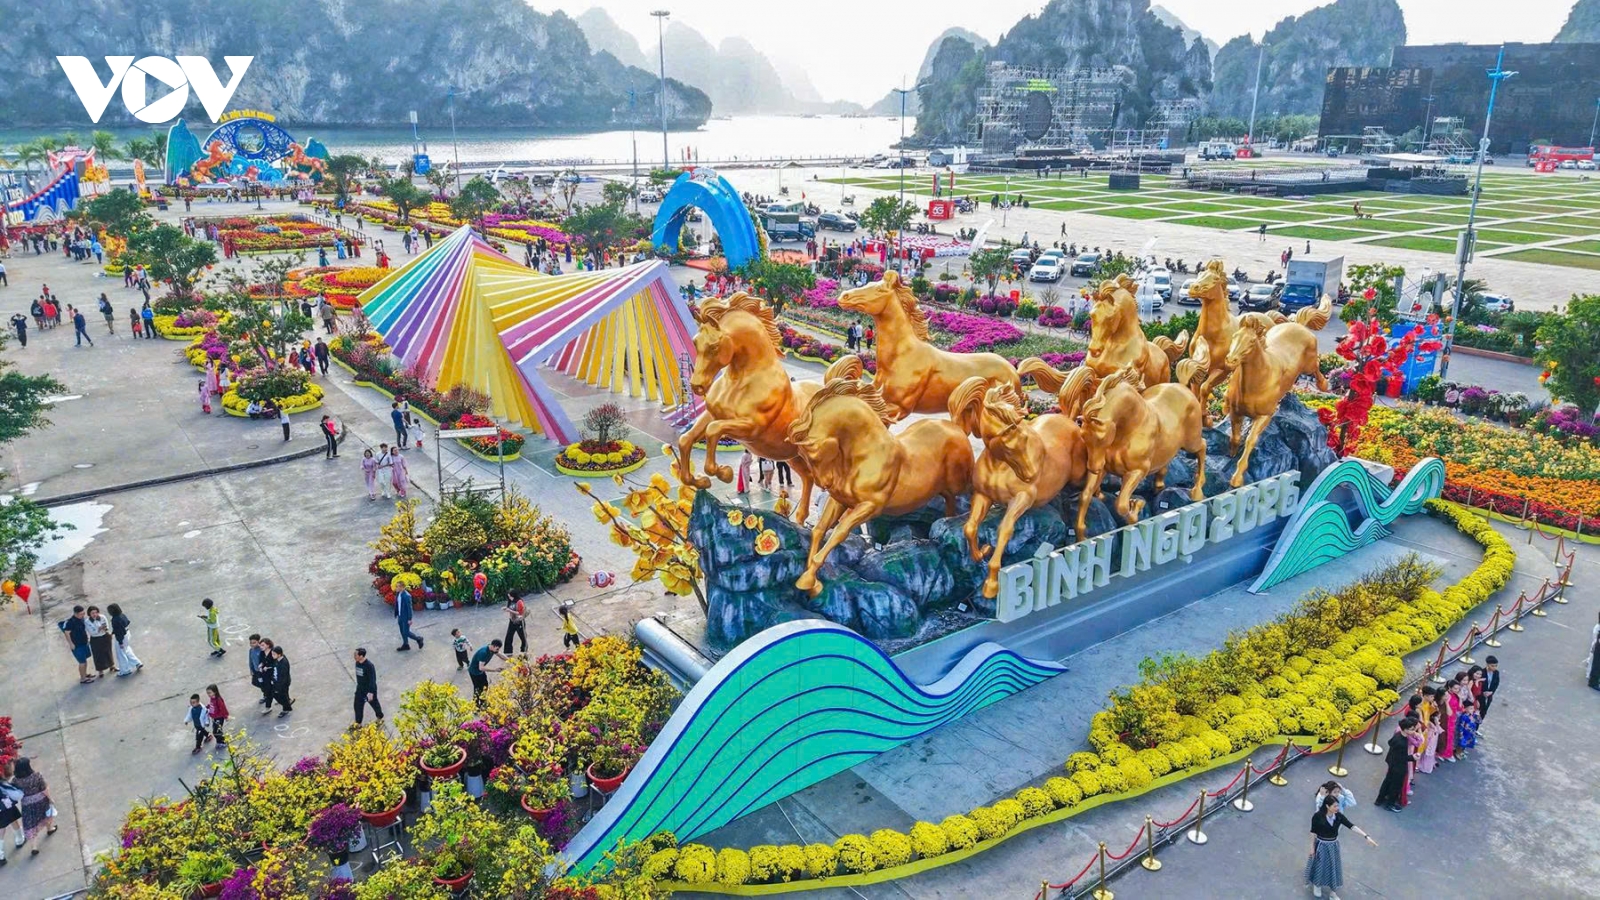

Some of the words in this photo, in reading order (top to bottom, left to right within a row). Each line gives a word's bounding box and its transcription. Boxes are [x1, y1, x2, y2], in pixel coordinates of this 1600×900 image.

[996, 534, 1113, 623] BÍNH
[1119, 502, 1207, 578] NGỌ
[1209, 469, 1301, 543] 2026
